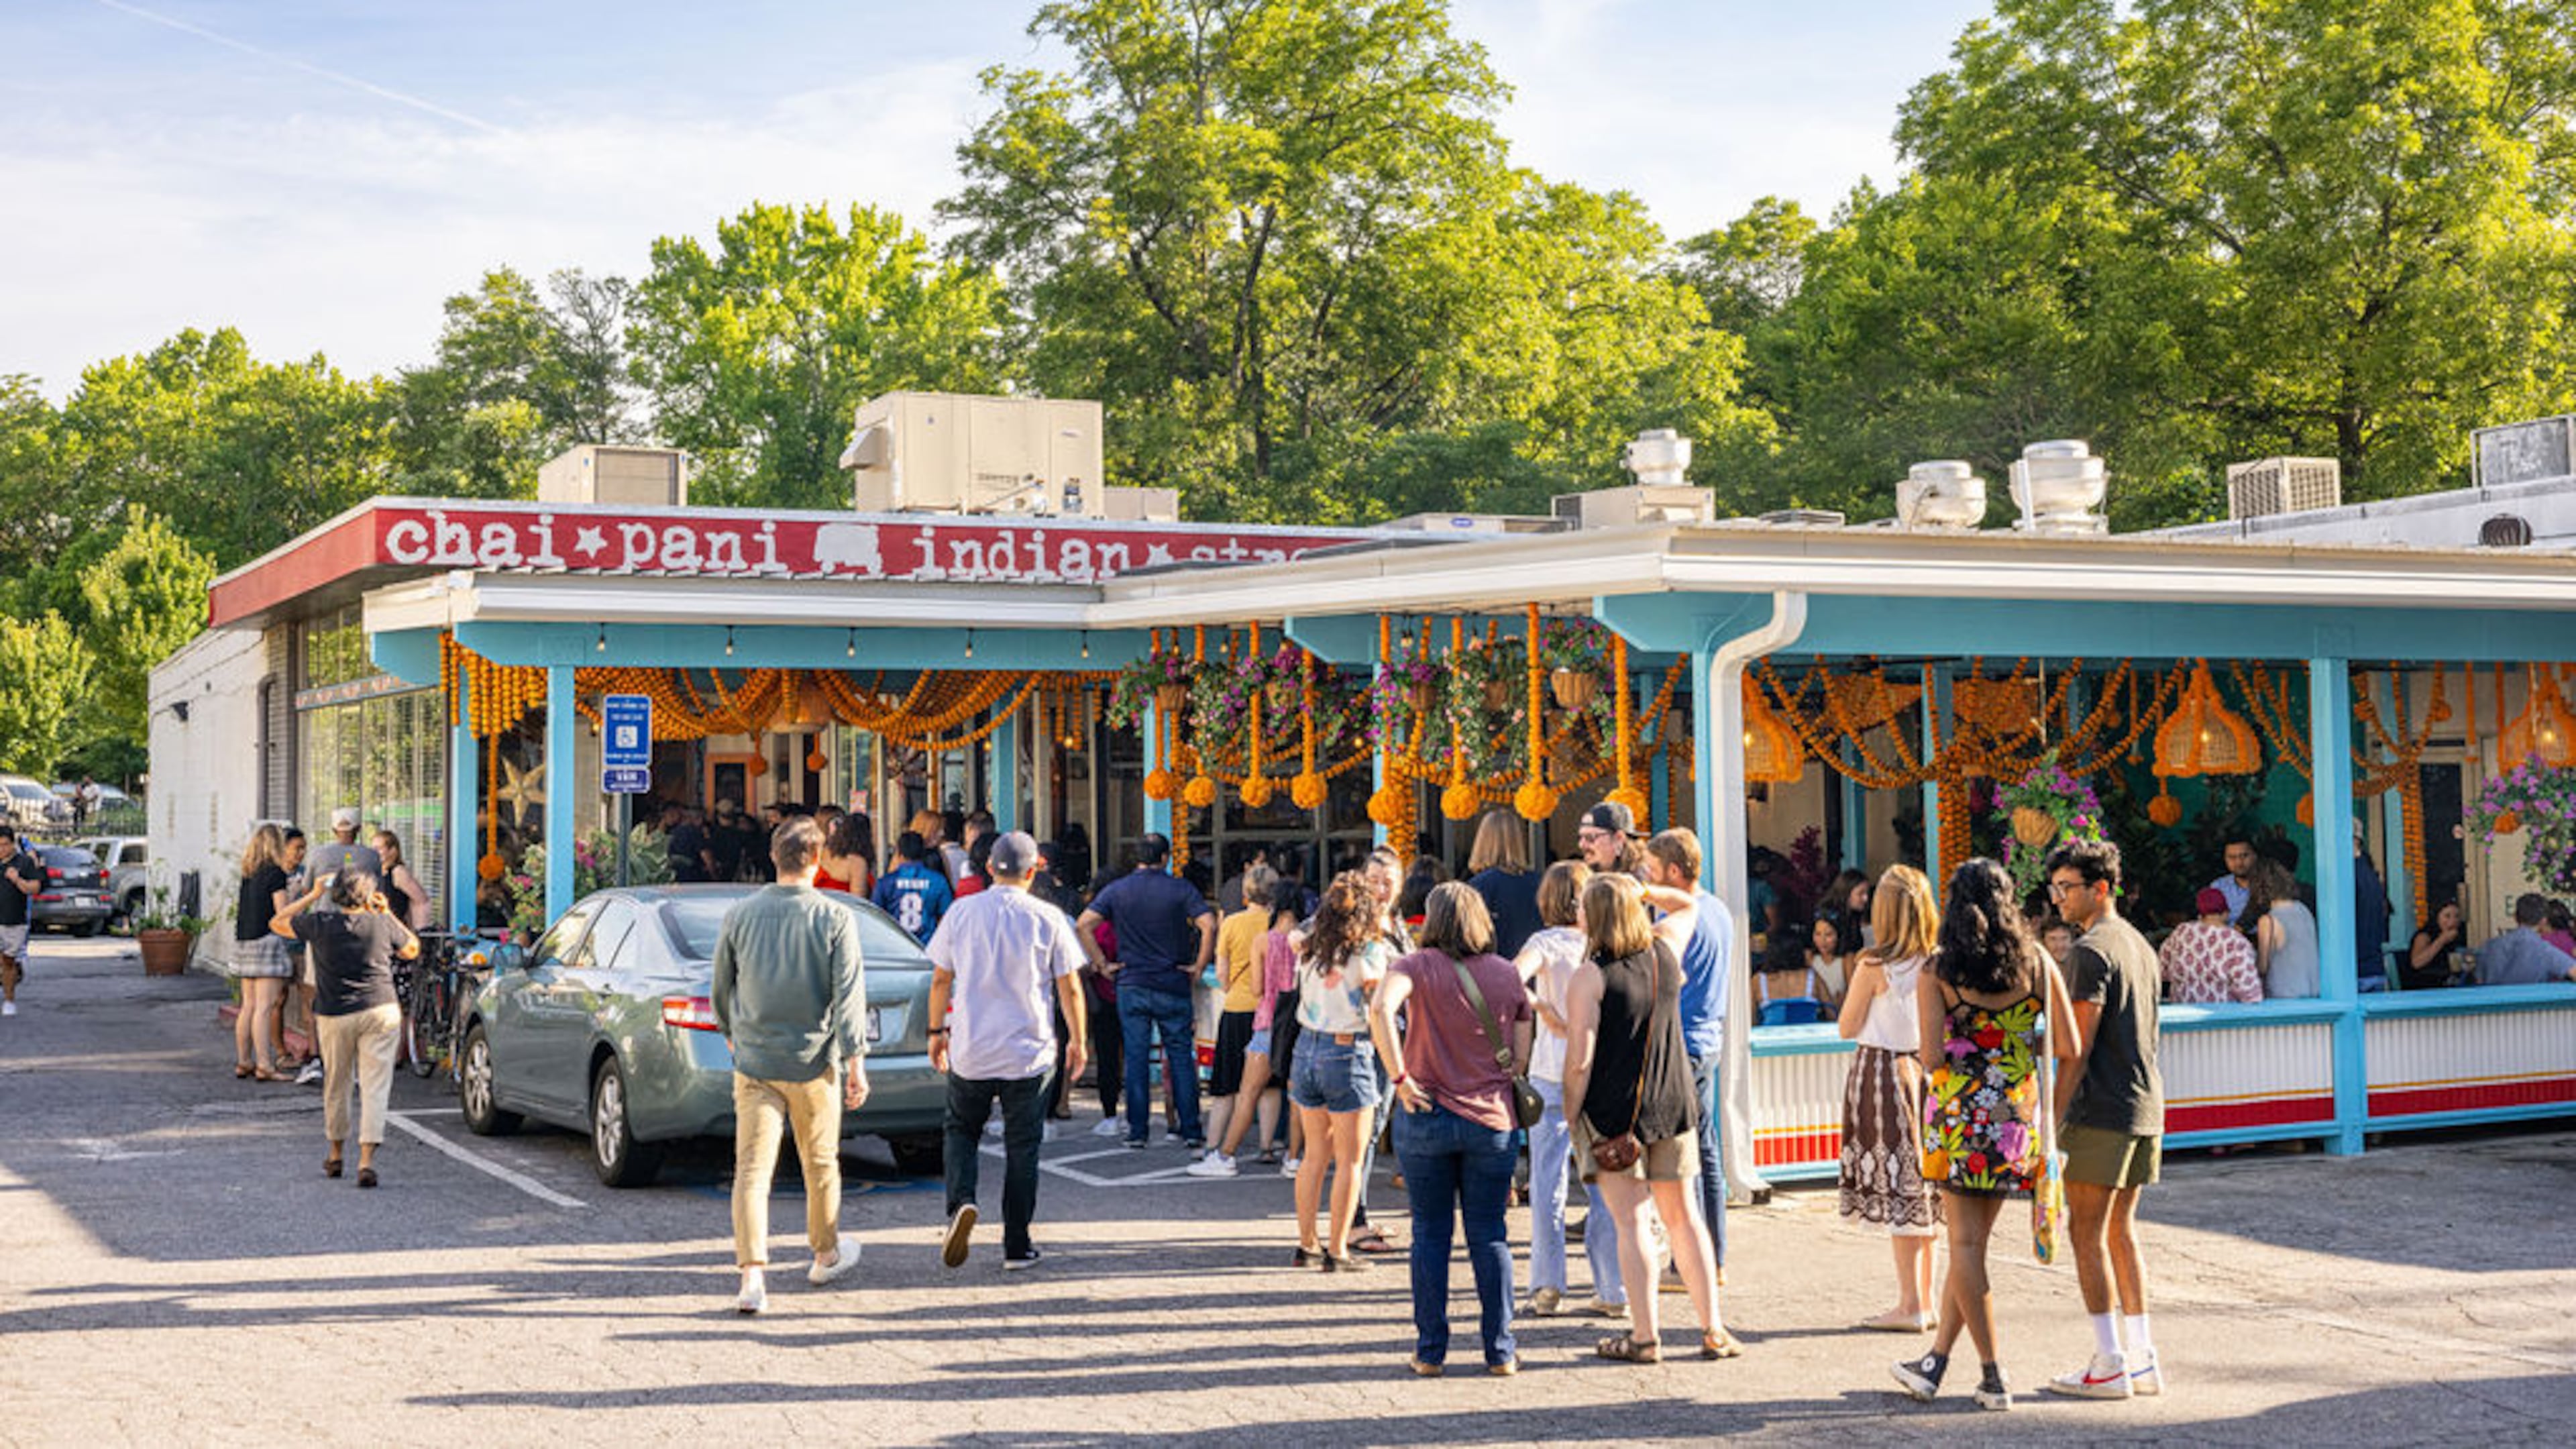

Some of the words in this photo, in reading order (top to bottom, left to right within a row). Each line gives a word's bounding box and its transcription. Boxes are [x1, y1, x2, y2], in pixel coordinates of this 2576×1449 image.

[386, 508, 565, 567] chai
[617, 520, 788, 572] pani
[912, 526, 1132, 580] indian
[900, 892, 922, 932] 8
